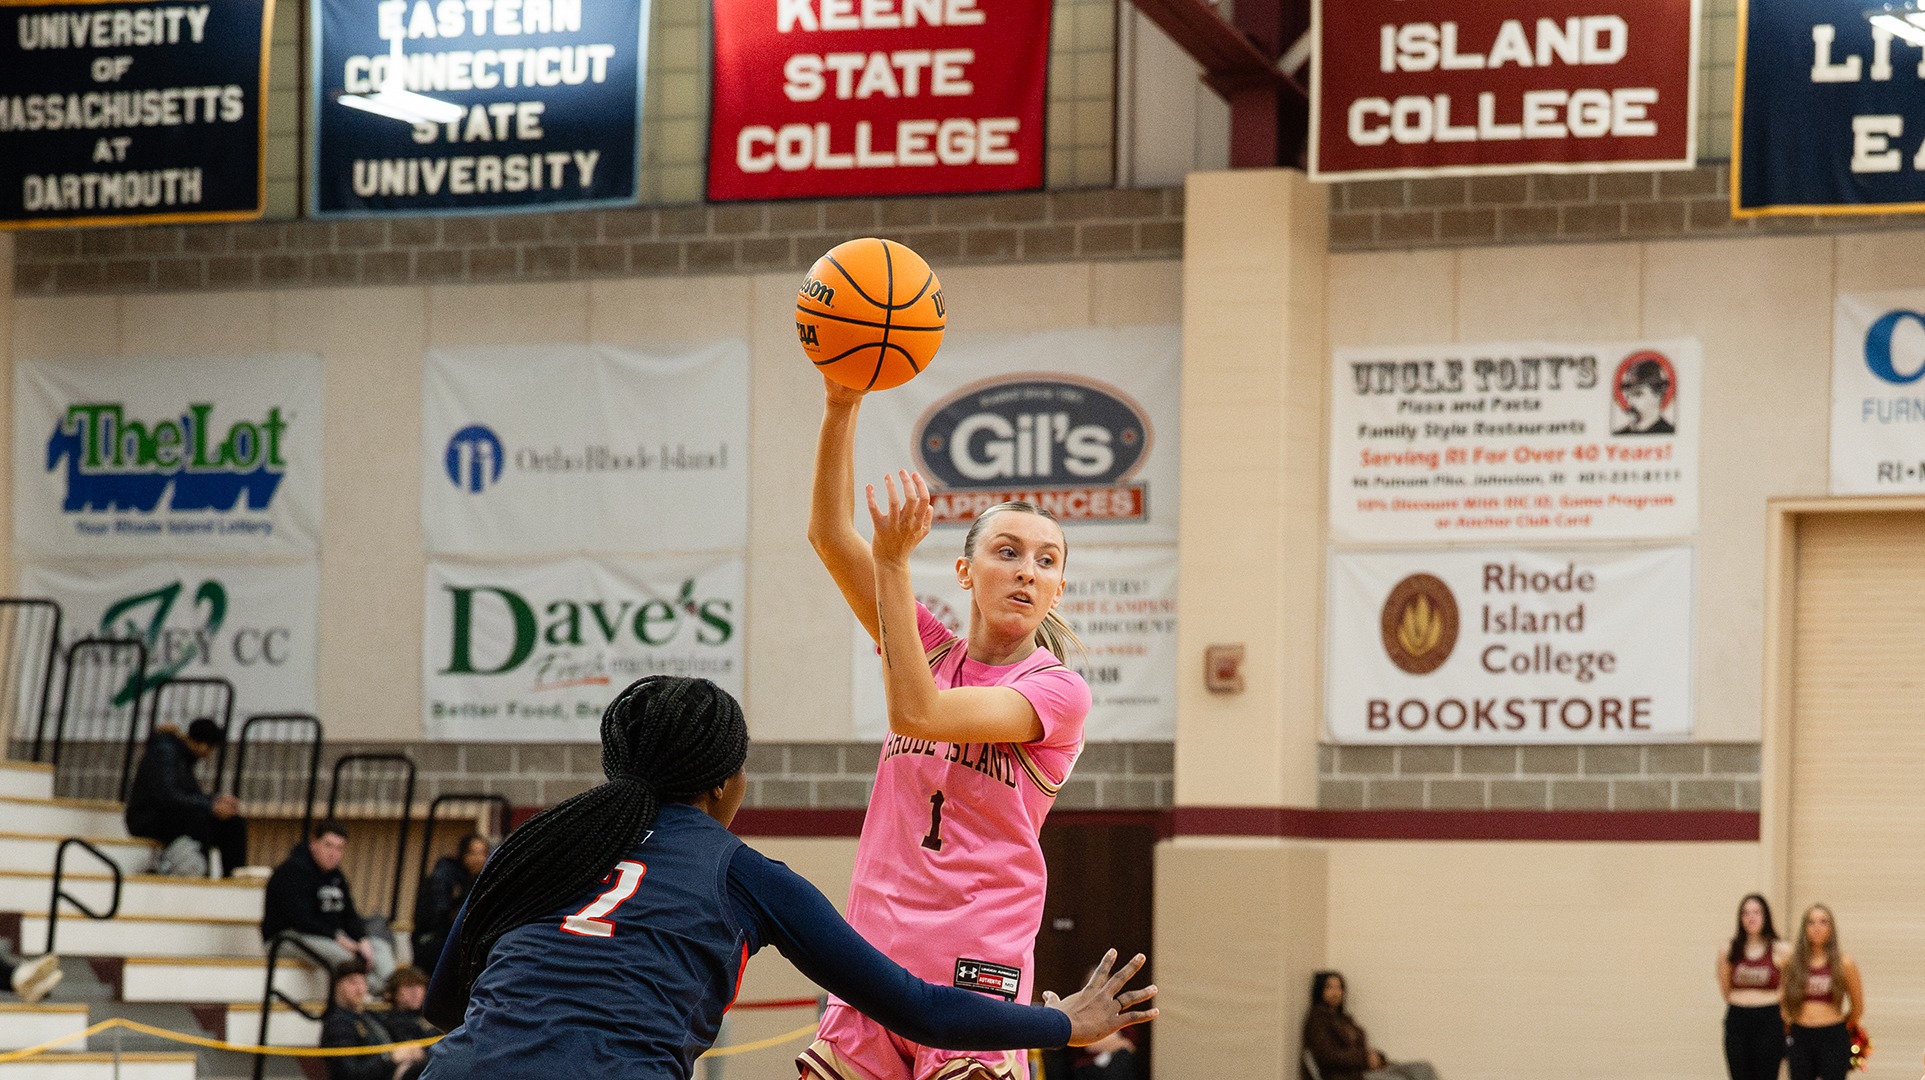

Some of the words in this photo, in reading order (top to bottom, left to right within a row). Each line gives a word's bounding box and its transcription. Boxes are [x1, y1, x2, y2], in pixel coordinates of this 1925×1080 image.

[18, 6, 210, 49] UNIVERSITY
[378, 0, 583, 40] EASTERN
[776, 0, 986, 33] KEENE
[1380, 14, 1629, 73] ISLAND
[91, 56, 134, 82] OF
[344, 43, 617, 94] CONNECTICUT
[784, 49, 975, 101] STATE
[411, 101, 546, 144] STATE
[1347, 88, 1659, 146] COLLEGE
[92, 136, 133, 163] AT
[737, 118, 1020, 172] COLLEGE
[1850, 114, 1925, 173] E
[23, 167, 203, 211] DARTMOUTH
[352, 151, 600, 196] UNIVERSITY
[1351, 360, 1464, 395] UNCLE
[1473, 354, 1597, 392] TONY'S
[1397, 400, 1446, 414] Pizza
[1450, 397, 1486, 412] and
[1490, 397, 1541, 411] Pasta
[951, 411, 1115, 481] Gil's
[1357, 422, 1418, 441] Family
[1423, 420, 1468, 440] Style
[1473, 418, 1586, 436] Restaurants
[1360, 447, 1440, 470] Serving
[1445, 446, 1467, 464] RI
[1472, 446, 1507, 464] For
[1513, 443, 1565, 464] Over
[1571, 442, 1600, 462] 40
[1605, 440, 1674, 461] Years!
[933, 486, 1135, 521] APPNCES
[1482, 563, 1595, 594] Rhode
[437, 578, 734, 677] Dave's
[1481, 602, 1586, 634] Island
[232, 627, 290, 667] CC
[1480, 643, 1617, 683] College
[1367, 698, 1652, 731] BOOKSTORE
[920, 789, 945, 852] 1
[560, 859, 647, 938] 2
